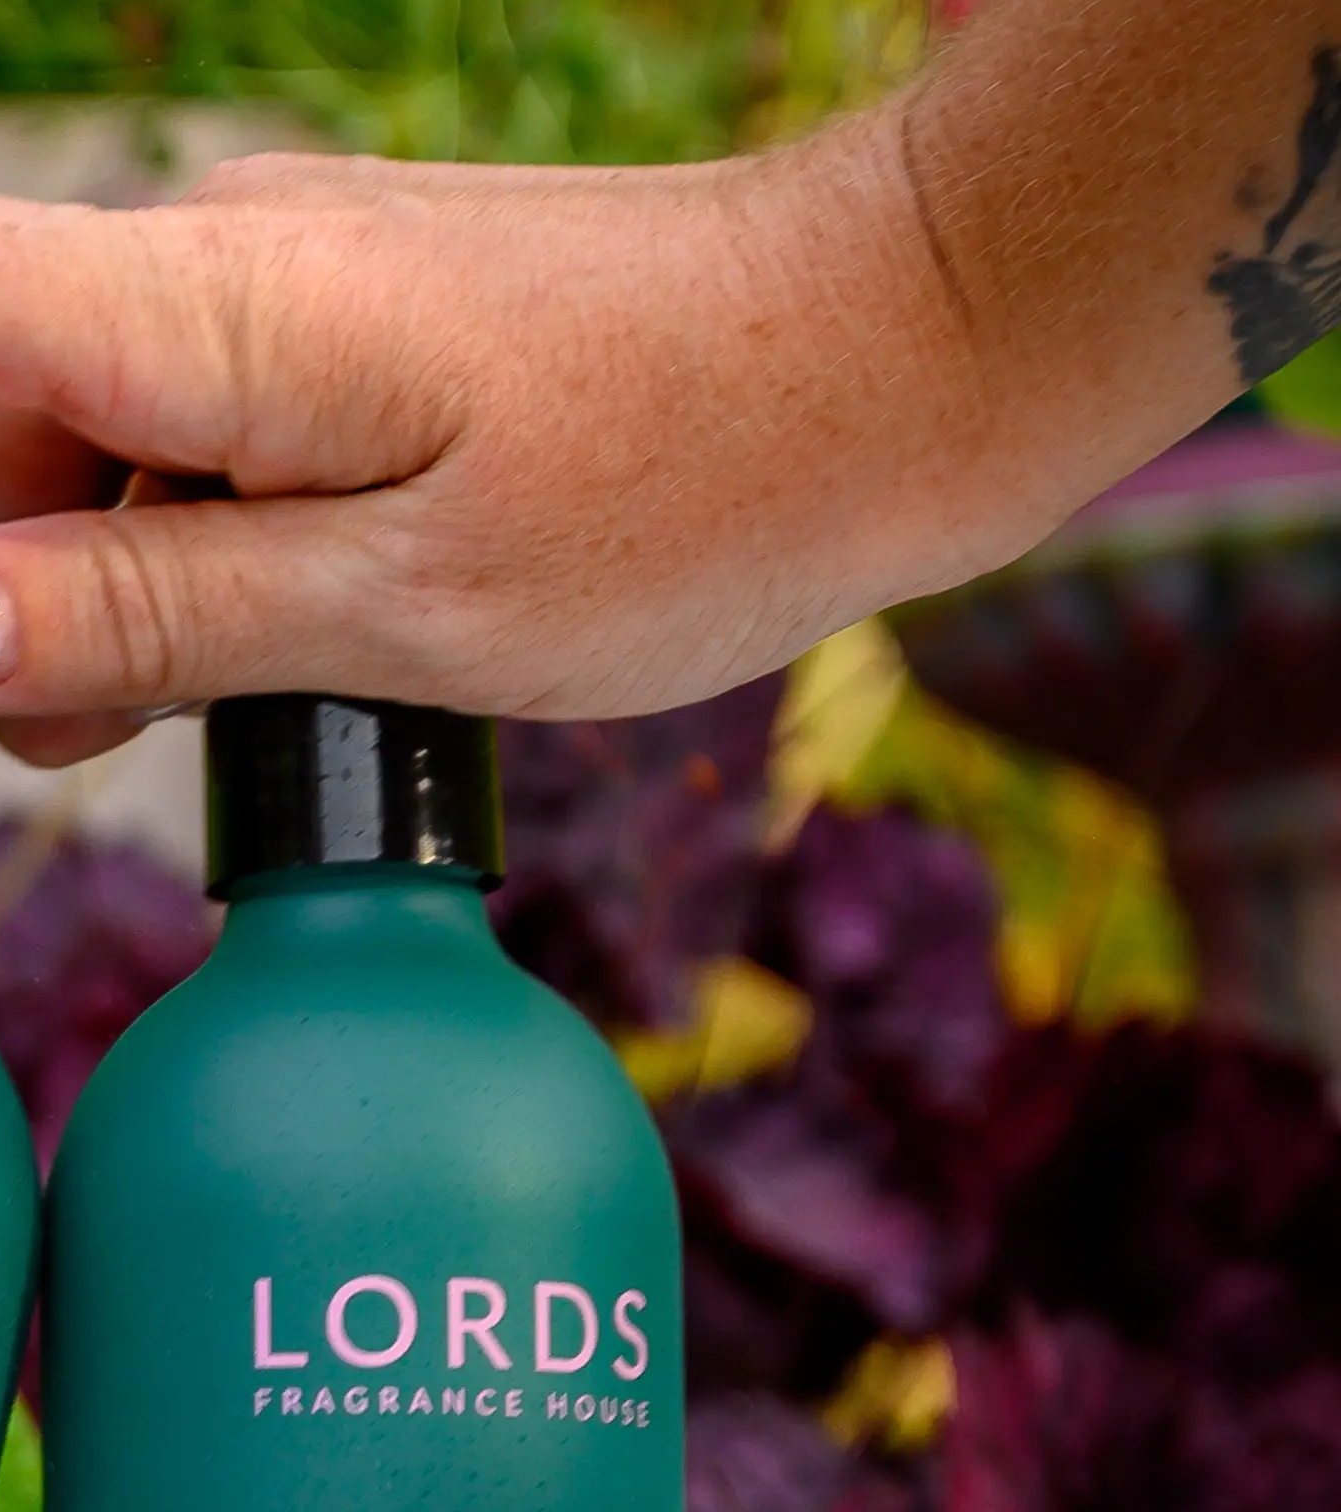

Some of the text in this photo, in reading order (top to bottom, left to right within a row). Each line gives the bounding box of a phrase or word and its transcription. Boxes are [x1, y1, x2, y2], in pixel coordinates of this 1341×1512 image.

[253, 1274, 648, 1381] LORDS
[254, 1386, 650, 1428] FRAGRANCE HOUSE
